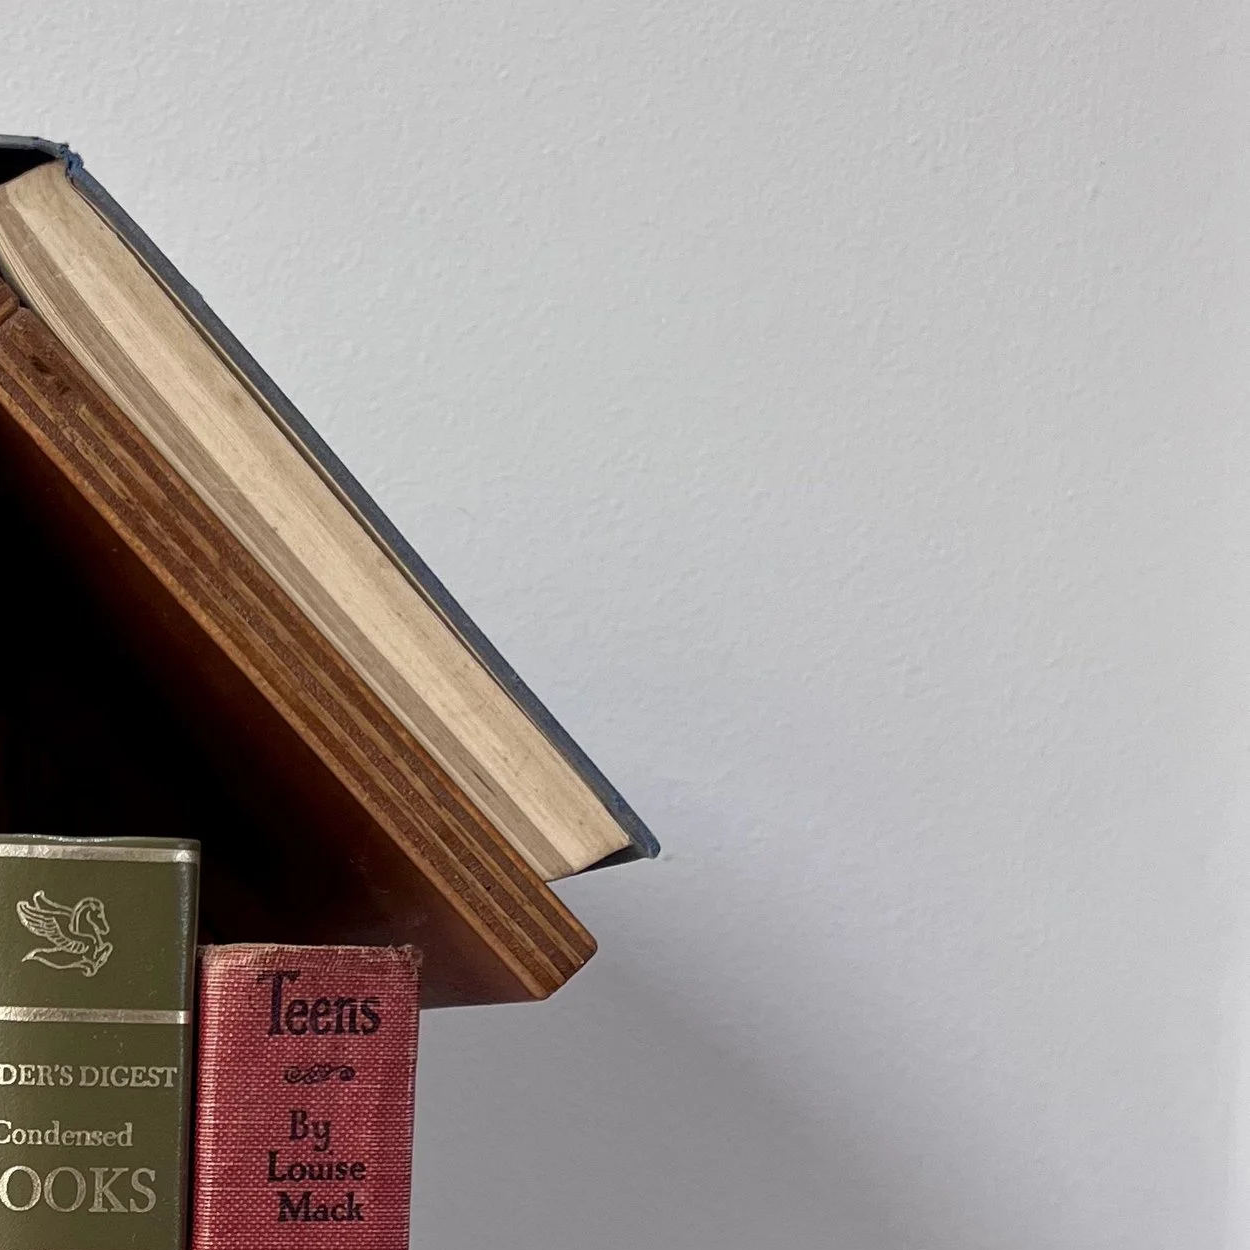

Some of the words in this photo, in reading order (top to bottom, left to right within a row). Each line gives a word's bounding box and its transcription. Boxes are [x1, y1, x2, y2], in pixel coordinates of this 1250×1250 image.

[257, 969, 382, 1036] Teens
[78, 1065, 178, 1088] DIGEST
[288, 1110, 332, 1151] By
[267, 1151, 367, 1182] Louise
[276, 1191, 365, 1223] Mack
